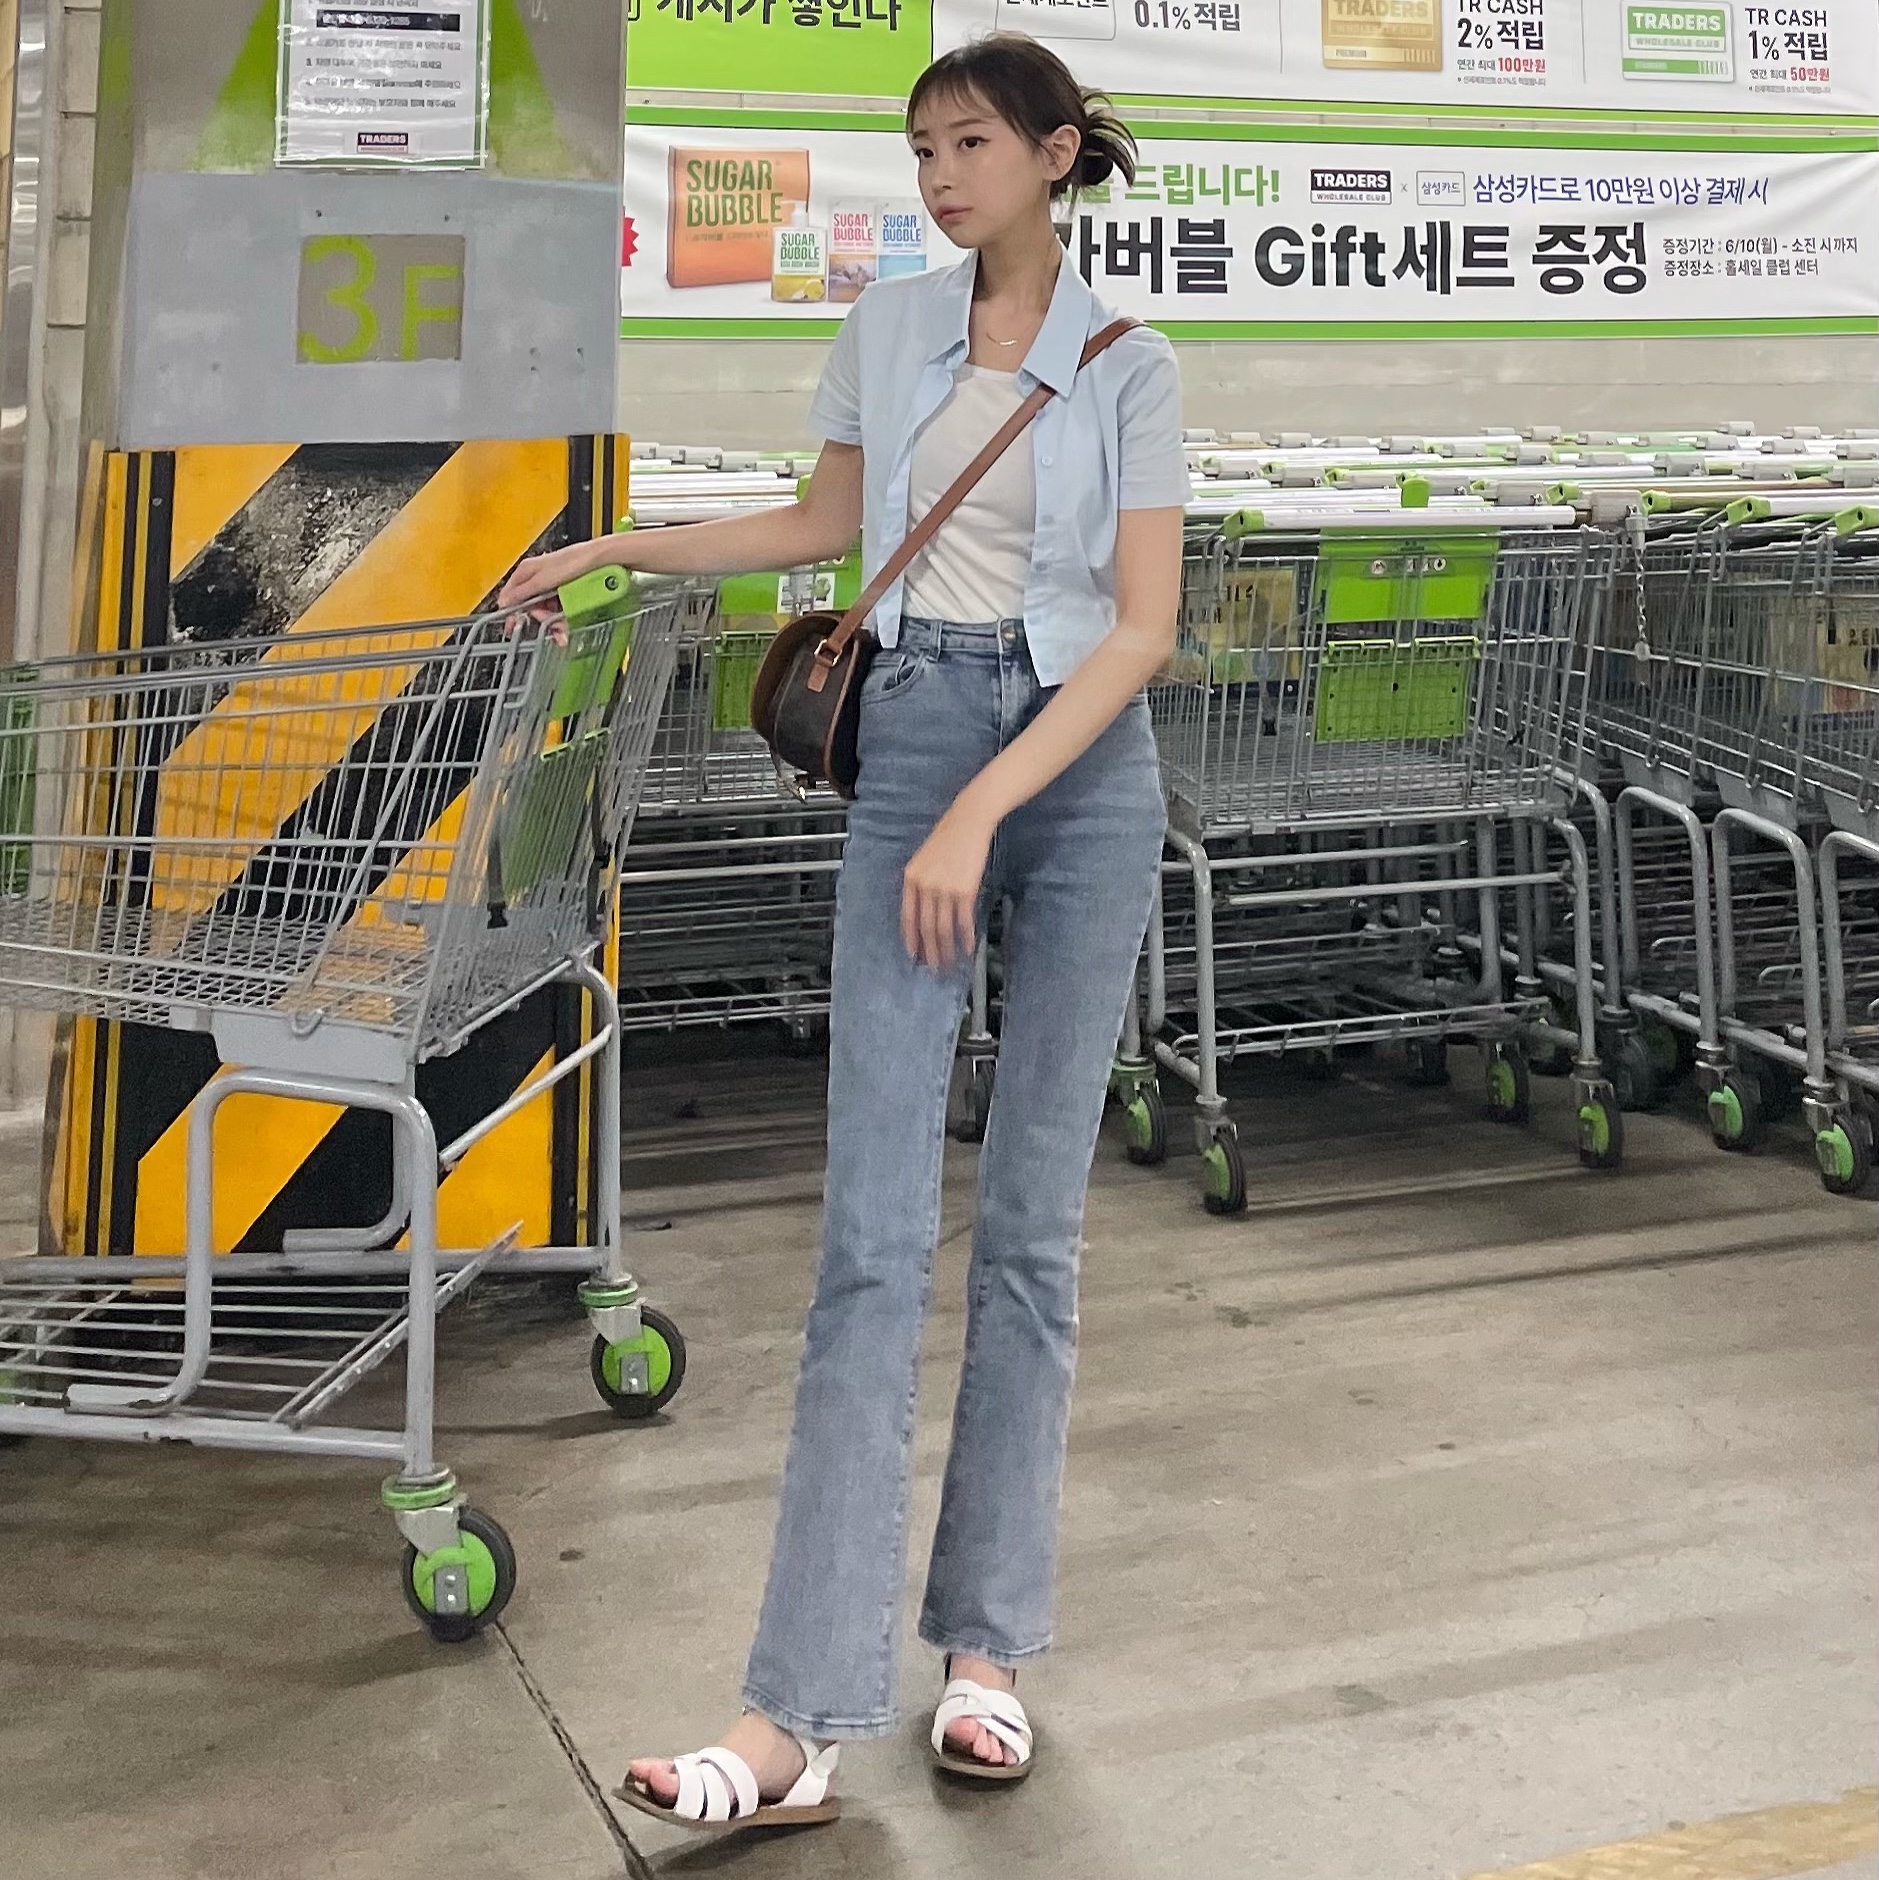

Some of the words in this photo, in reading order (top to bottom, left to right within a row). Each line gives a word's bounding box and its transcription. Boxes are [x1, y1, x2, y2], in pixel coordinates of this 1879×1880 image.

[1335, 0, 1429, 18] TRADERS
[1487, 0, 1544, 15] CASH
[1134, 0, 1191, 30] 0.1%
[1194, 3, 1241, 32] 적립
[1632, 12, 1722, 31] TRADERS
[1745, 7, 1769, 25] TR
[1774, 9, 1828, 28] CASH
[1457, 18, 1493, 49] 2%
[1497, 19, 1545, 51] 적립
[1748, 30, 1780, 60] 1%
[1784, 31, 1829, 61] 적립
[1498, 57, 1547, 73] 100만원
[1790, 67, 1830, 82] 50만원
[360, 134, 406, 144] TRADERS
[686, 159, 773, 192] SUGAR
[1313, 173, 1388, 188] TRADERS
[1125, 163, 1280, 207] 드립니다!
[1421, 181, 1461, 196] 삼성카드
[1472, 173, 1582, 204] 삼성카드로
[1585, 175, 1656, 205] 10만원
[1659, 177, 1701, 205] 이상
[1706, 177, 1746, 205] 결제
[1748, 178, 1769, 205] 시
[1316, 193, 1364, 201] WHOLESALE
[686, 193, 783, 227] BUBBLE
[833, 213, 869, 227] SUGAR
[882, 214, 917, 228] SUGAR
[780, 233, 815, 246] SUGAR
[833, 227, 874, 241] BUBBLE
[882, 228, 922, 242] BUBBLE
[780, 246, 820, 260] BUBBLE
[1663, 238, 1714, 254] 증정기간
[1725, 237, 1778, 254] 6/10(월)
[1791, 238, 1817, 253] 소진
[1532, 222, 1647, 295] 증정
[1664, 260, 1714, 276] 증정장소
[1725, 260, 1762, 276] 홀세일
[1766, 259, 1790, 276] 클럽
[1794, 259, 1819, 276] 센터
